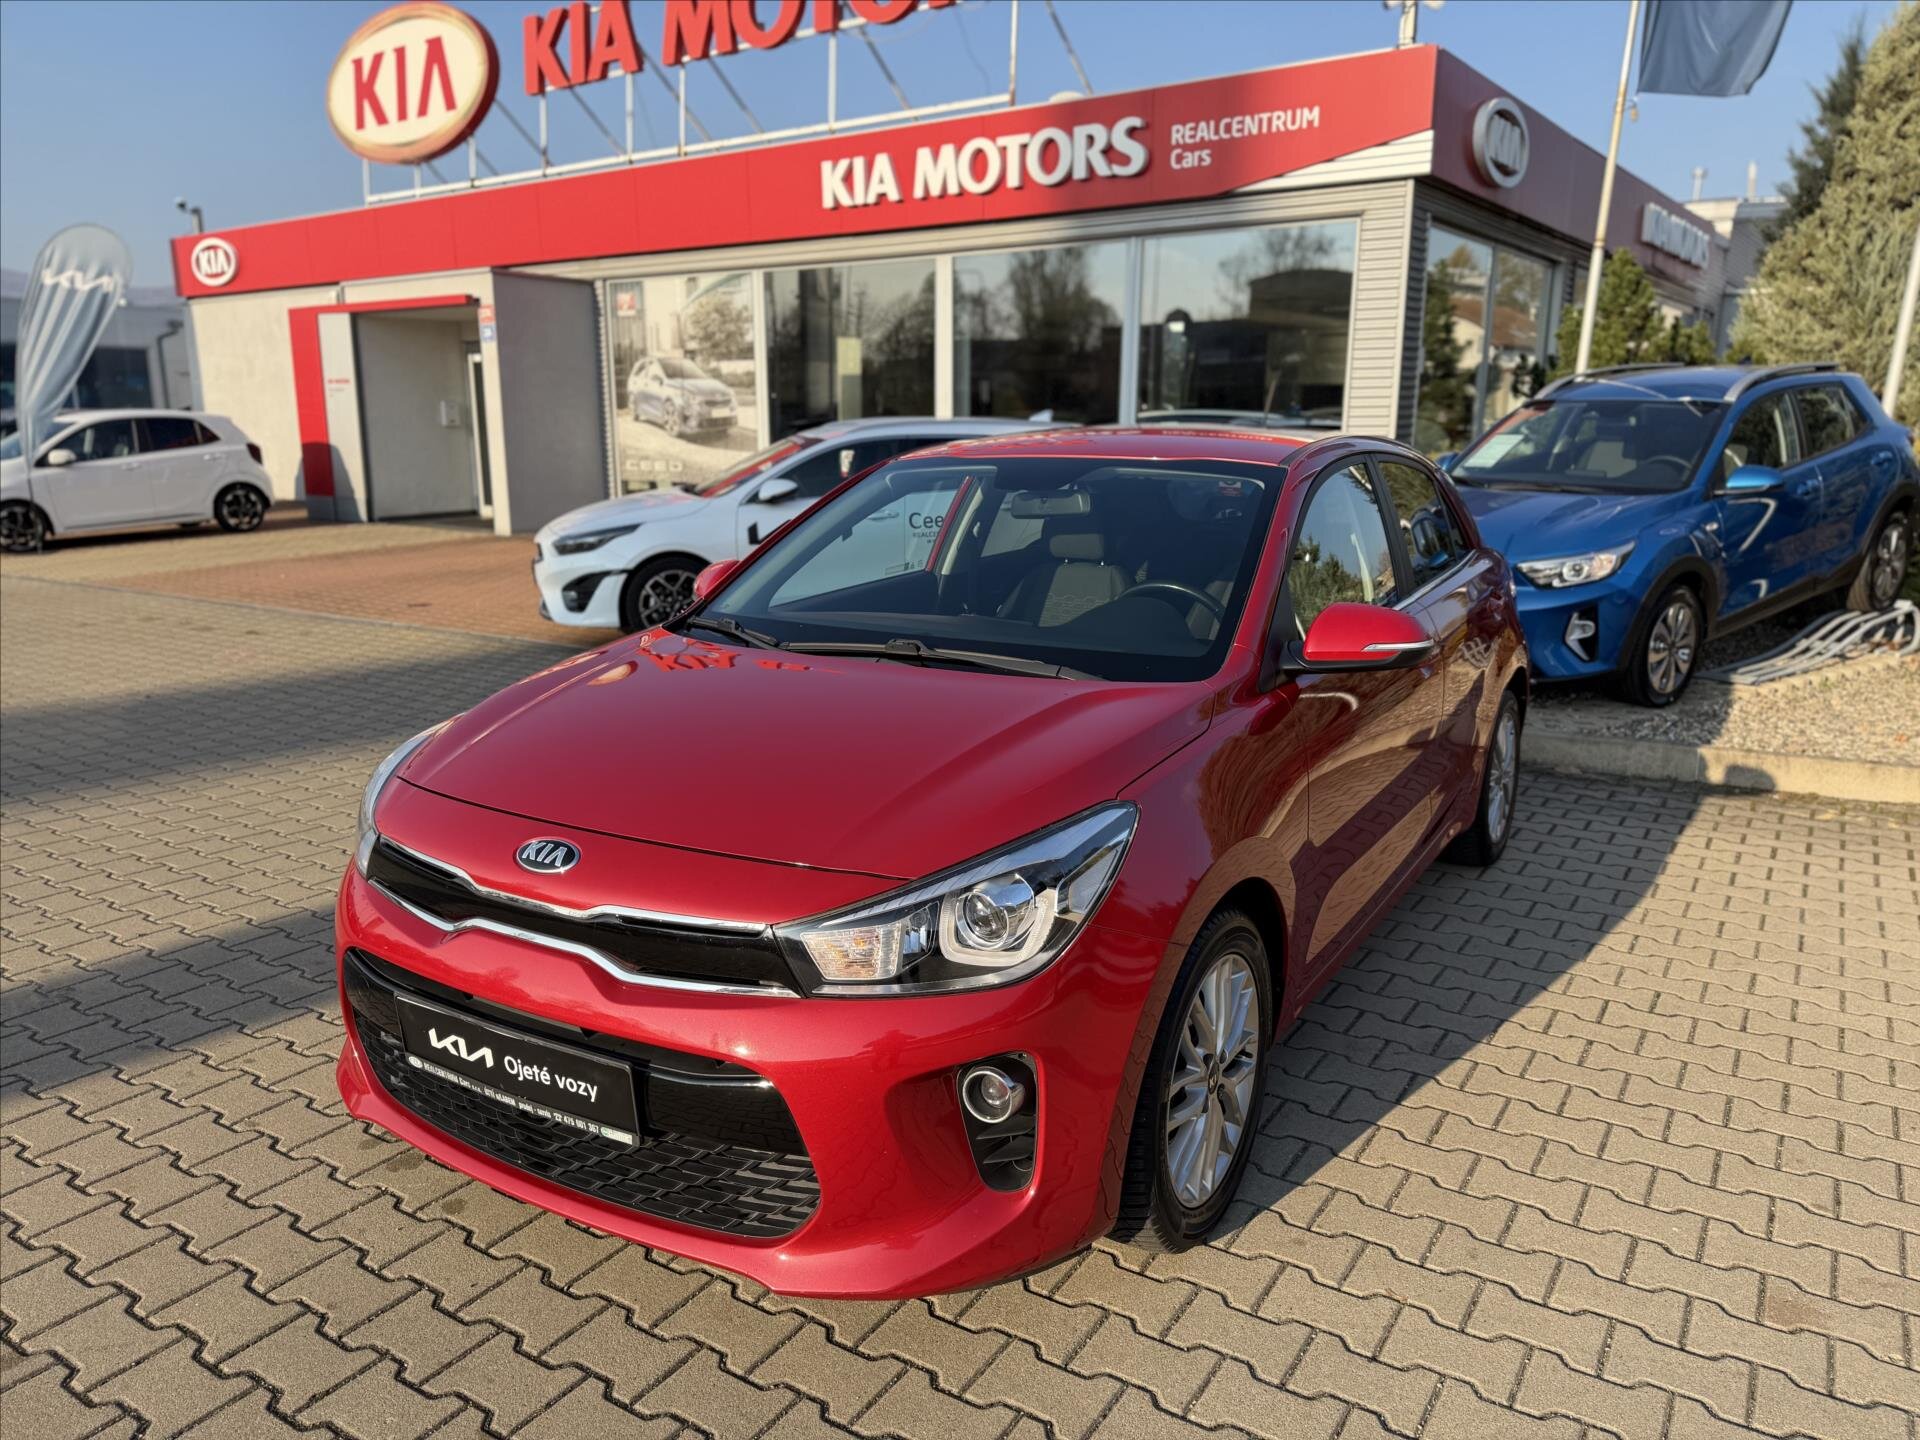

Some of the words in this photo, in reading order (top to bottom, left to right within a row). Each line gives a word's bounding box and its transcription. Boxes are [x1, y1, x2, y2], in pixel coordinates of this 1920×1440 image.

[524, 0, 641, 95] KIA
[351, 36, 457, 131] KIA
[1170, 106, 1321, 146] REALCENTRUM
[819, 152, 901, 209] KIA
[913, 115, 1148, 200] MOTORS
[1170, 148, 1212, 170] Cars
[199, 248, 231, 277] KIA
[521, 842, 568, 867] KIA
[428, 1028, 495, 1069] KIA
[503, 1055, 551, 1086] Ojeté
[555, 1074, 598, 1103] vozy
